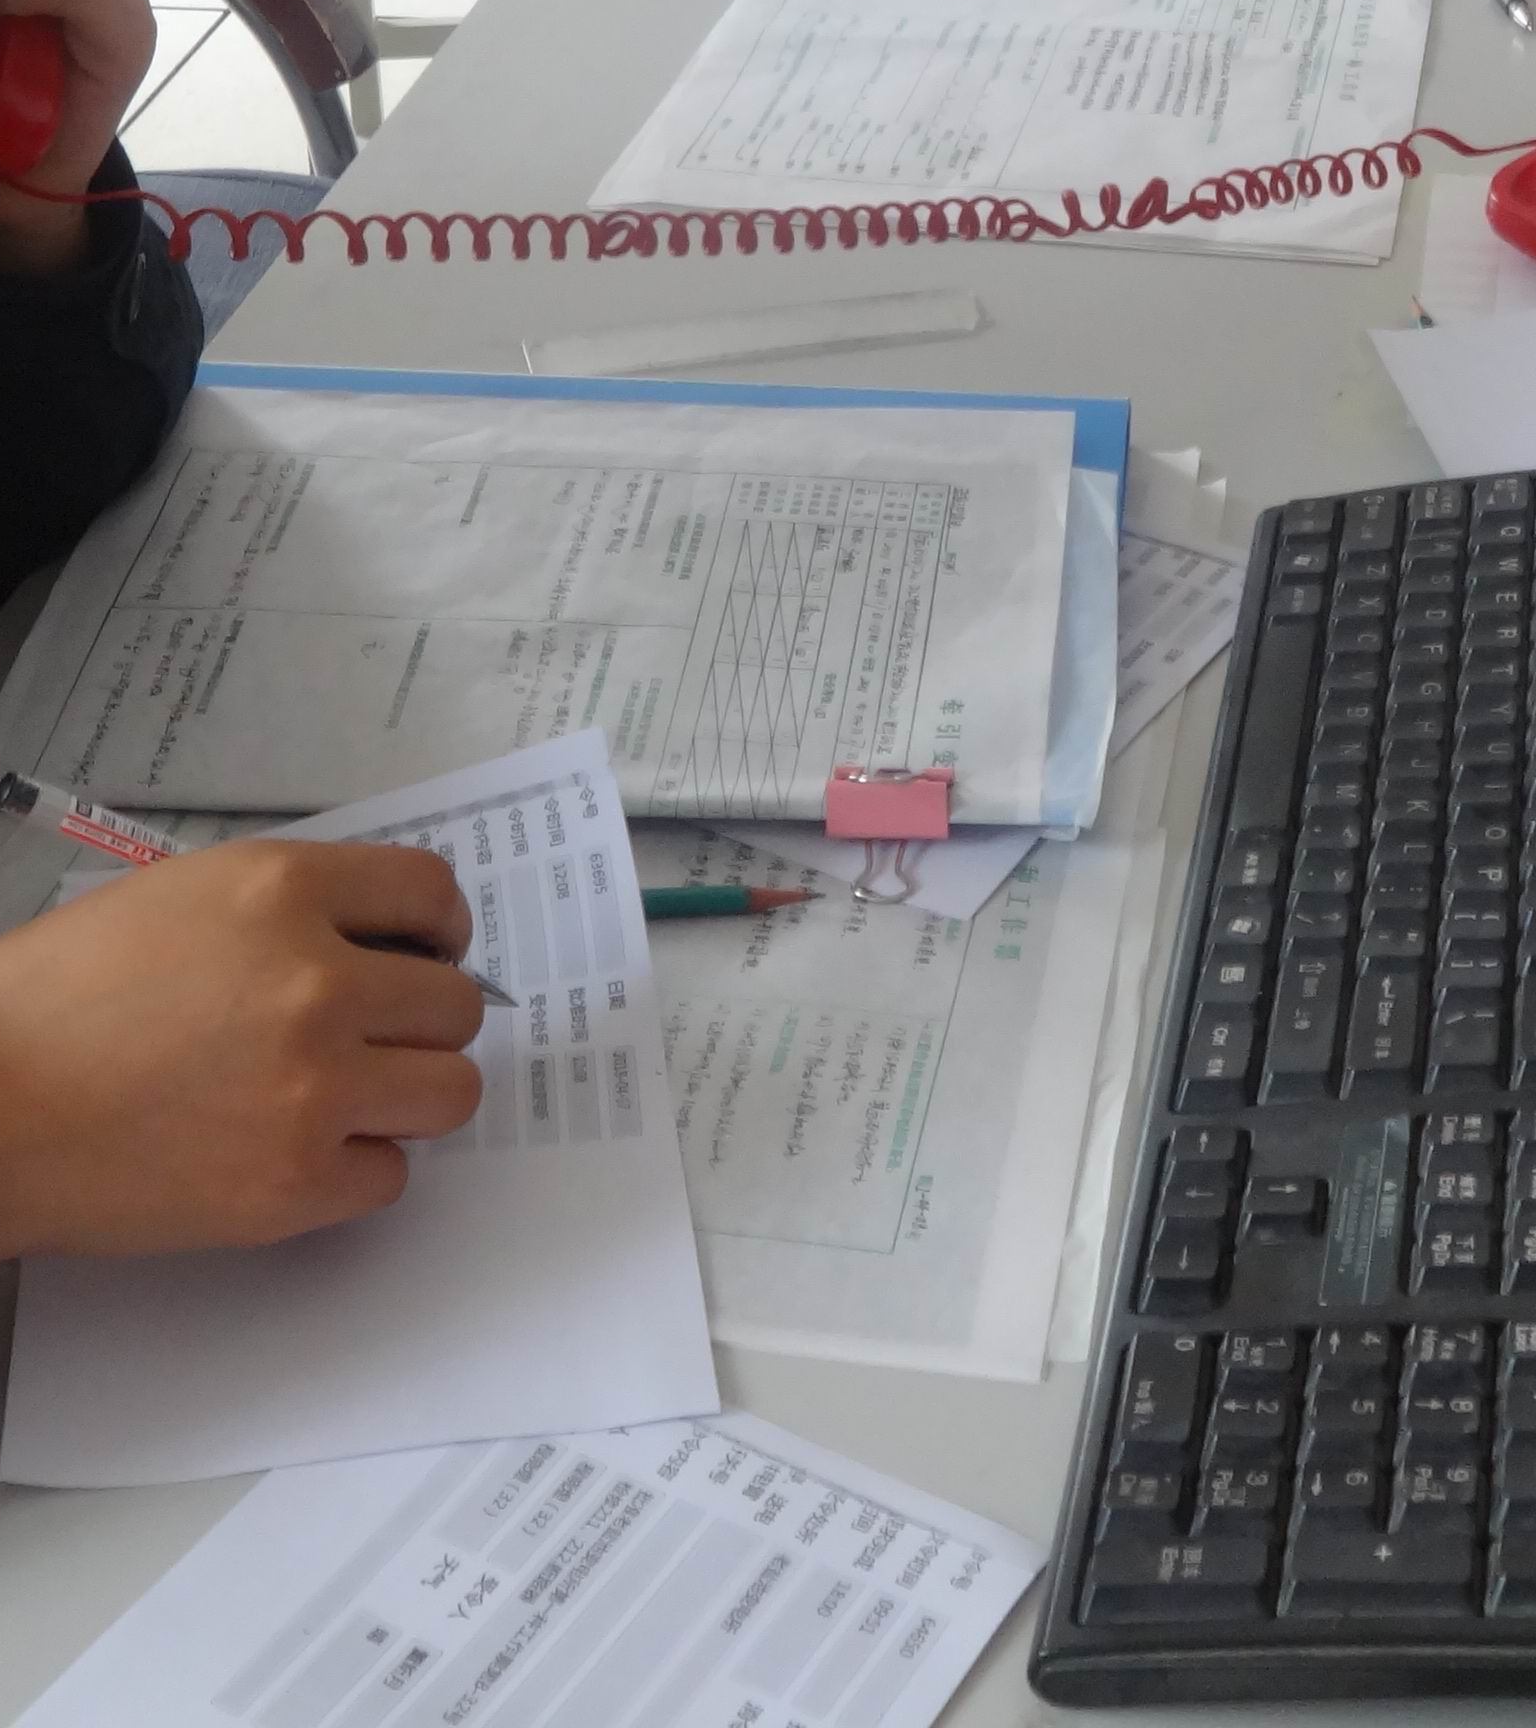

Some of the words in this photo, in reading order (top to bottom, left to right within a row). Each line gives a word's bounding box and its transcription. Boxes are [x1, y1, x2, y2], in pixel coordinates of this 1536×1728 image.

[589, 851, 609, 896] 63695
[607, 980, 627, 1011] 日期
[1436, 1173, 1458, 1198] End
